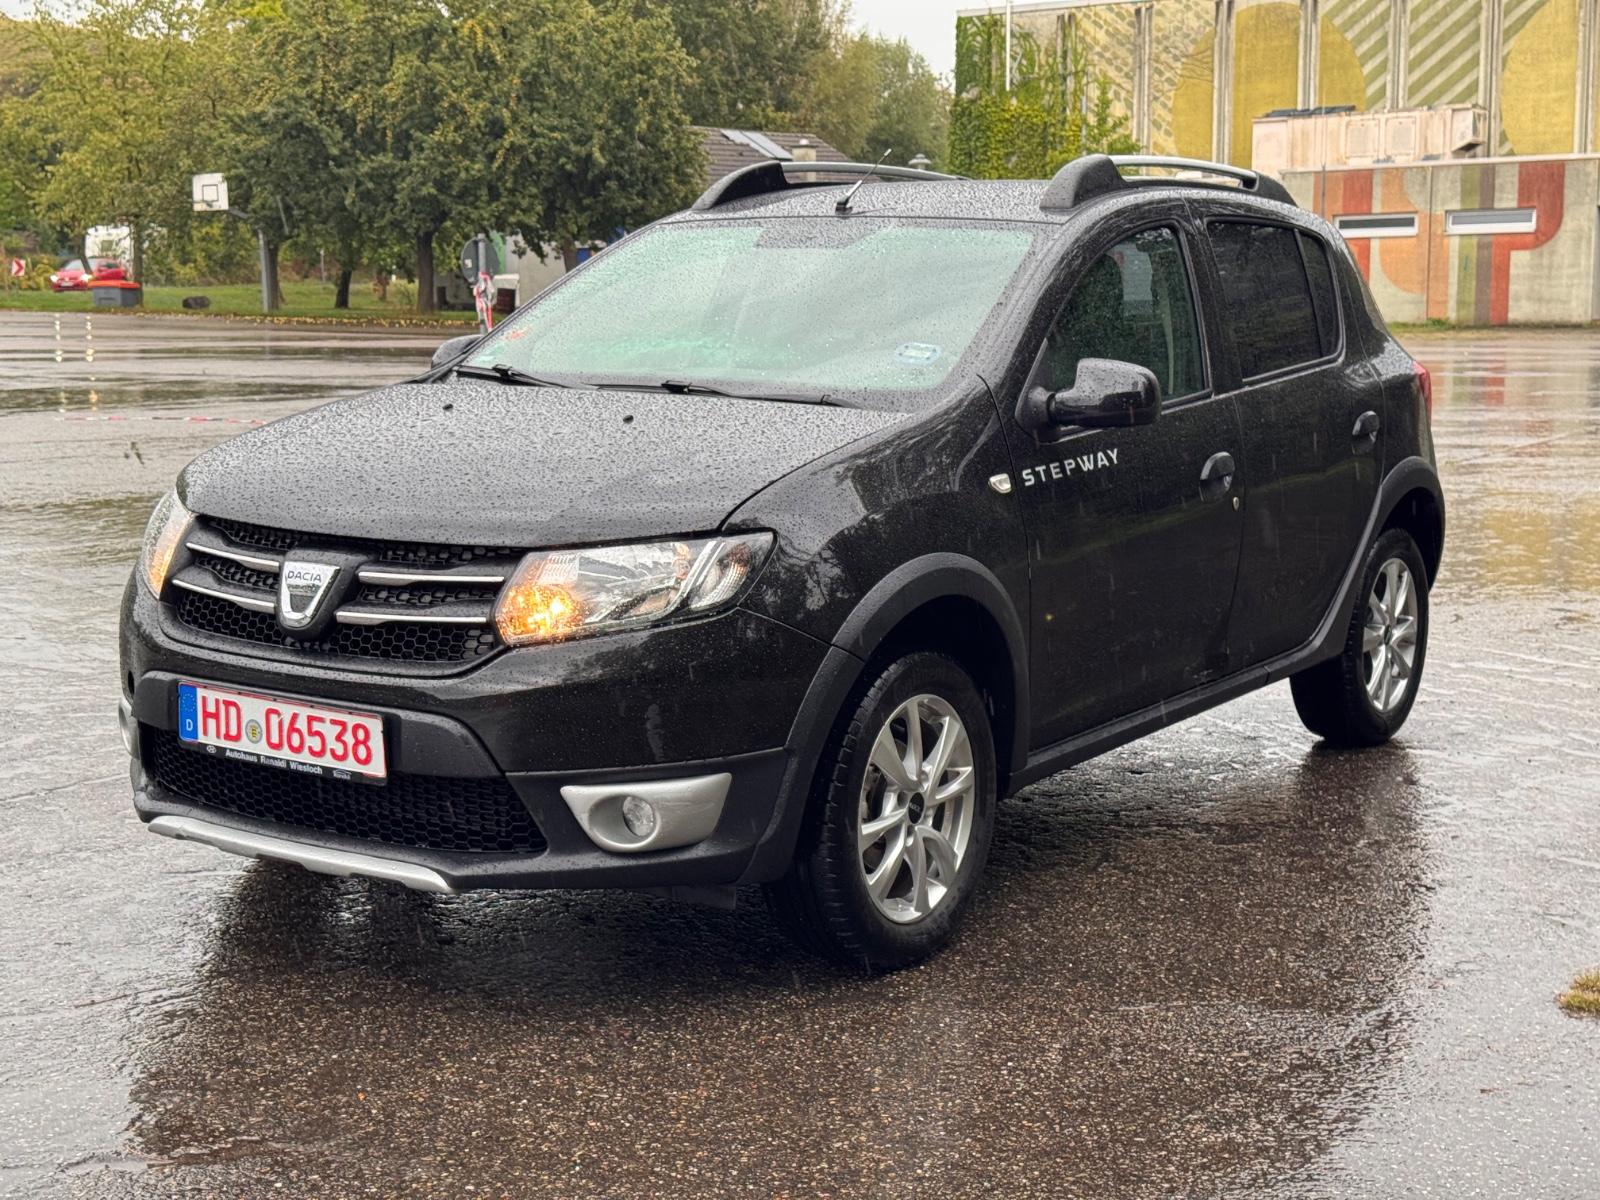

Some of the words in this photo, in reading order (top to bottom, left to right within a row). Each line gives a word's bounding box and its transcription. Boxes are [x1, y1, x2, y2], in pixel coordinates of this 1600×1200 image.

[1022, 448, 1118, 486] STEPWAY
[287, 570, 321, 583] DACIA
[186, 718, 193, 731] D
[202, 695, 242, 742] HD
[265, 707, 373, 766] 06538
[225, 749, 258, 763] Autohaus
[289, 761, 323, 775] Wiesloch
